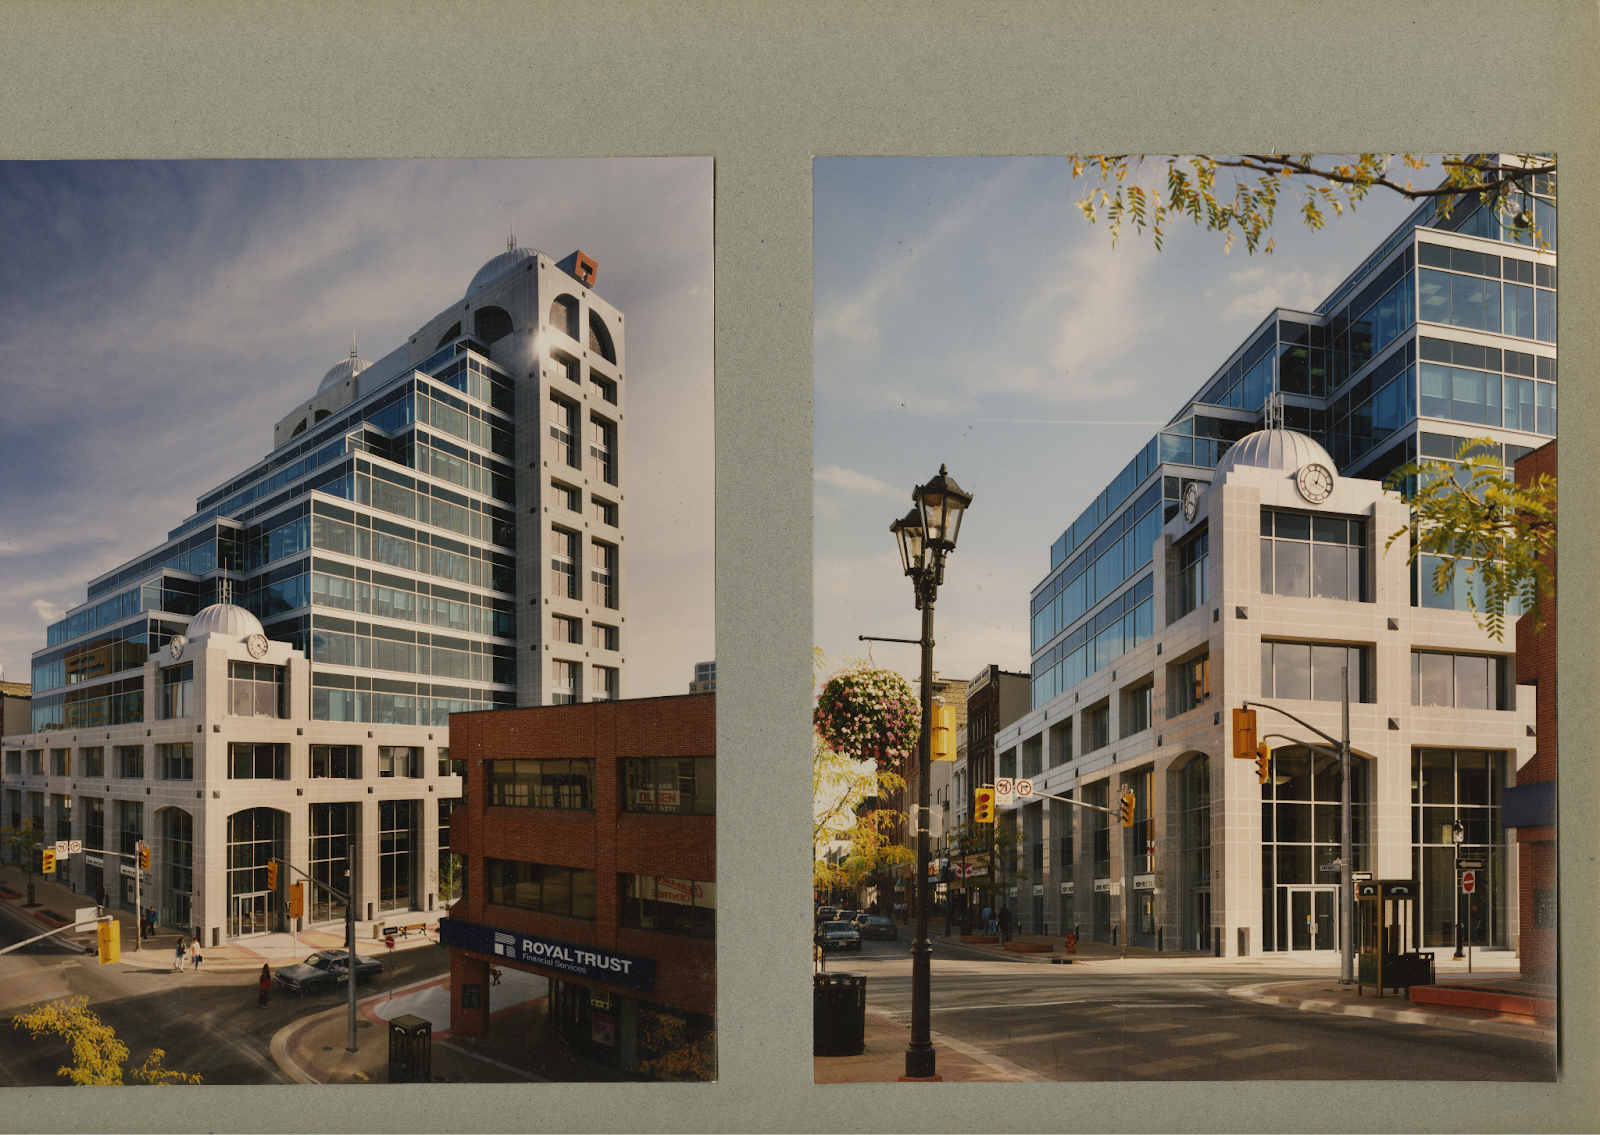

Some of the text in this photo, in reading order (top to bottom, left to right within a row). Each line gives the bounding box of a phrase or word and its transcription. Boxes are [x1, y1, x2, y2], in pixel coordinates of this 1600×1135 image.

[522, 939, 632, 974] ROYAL TRUST
[522, 953, 587, 974] Financial Services
